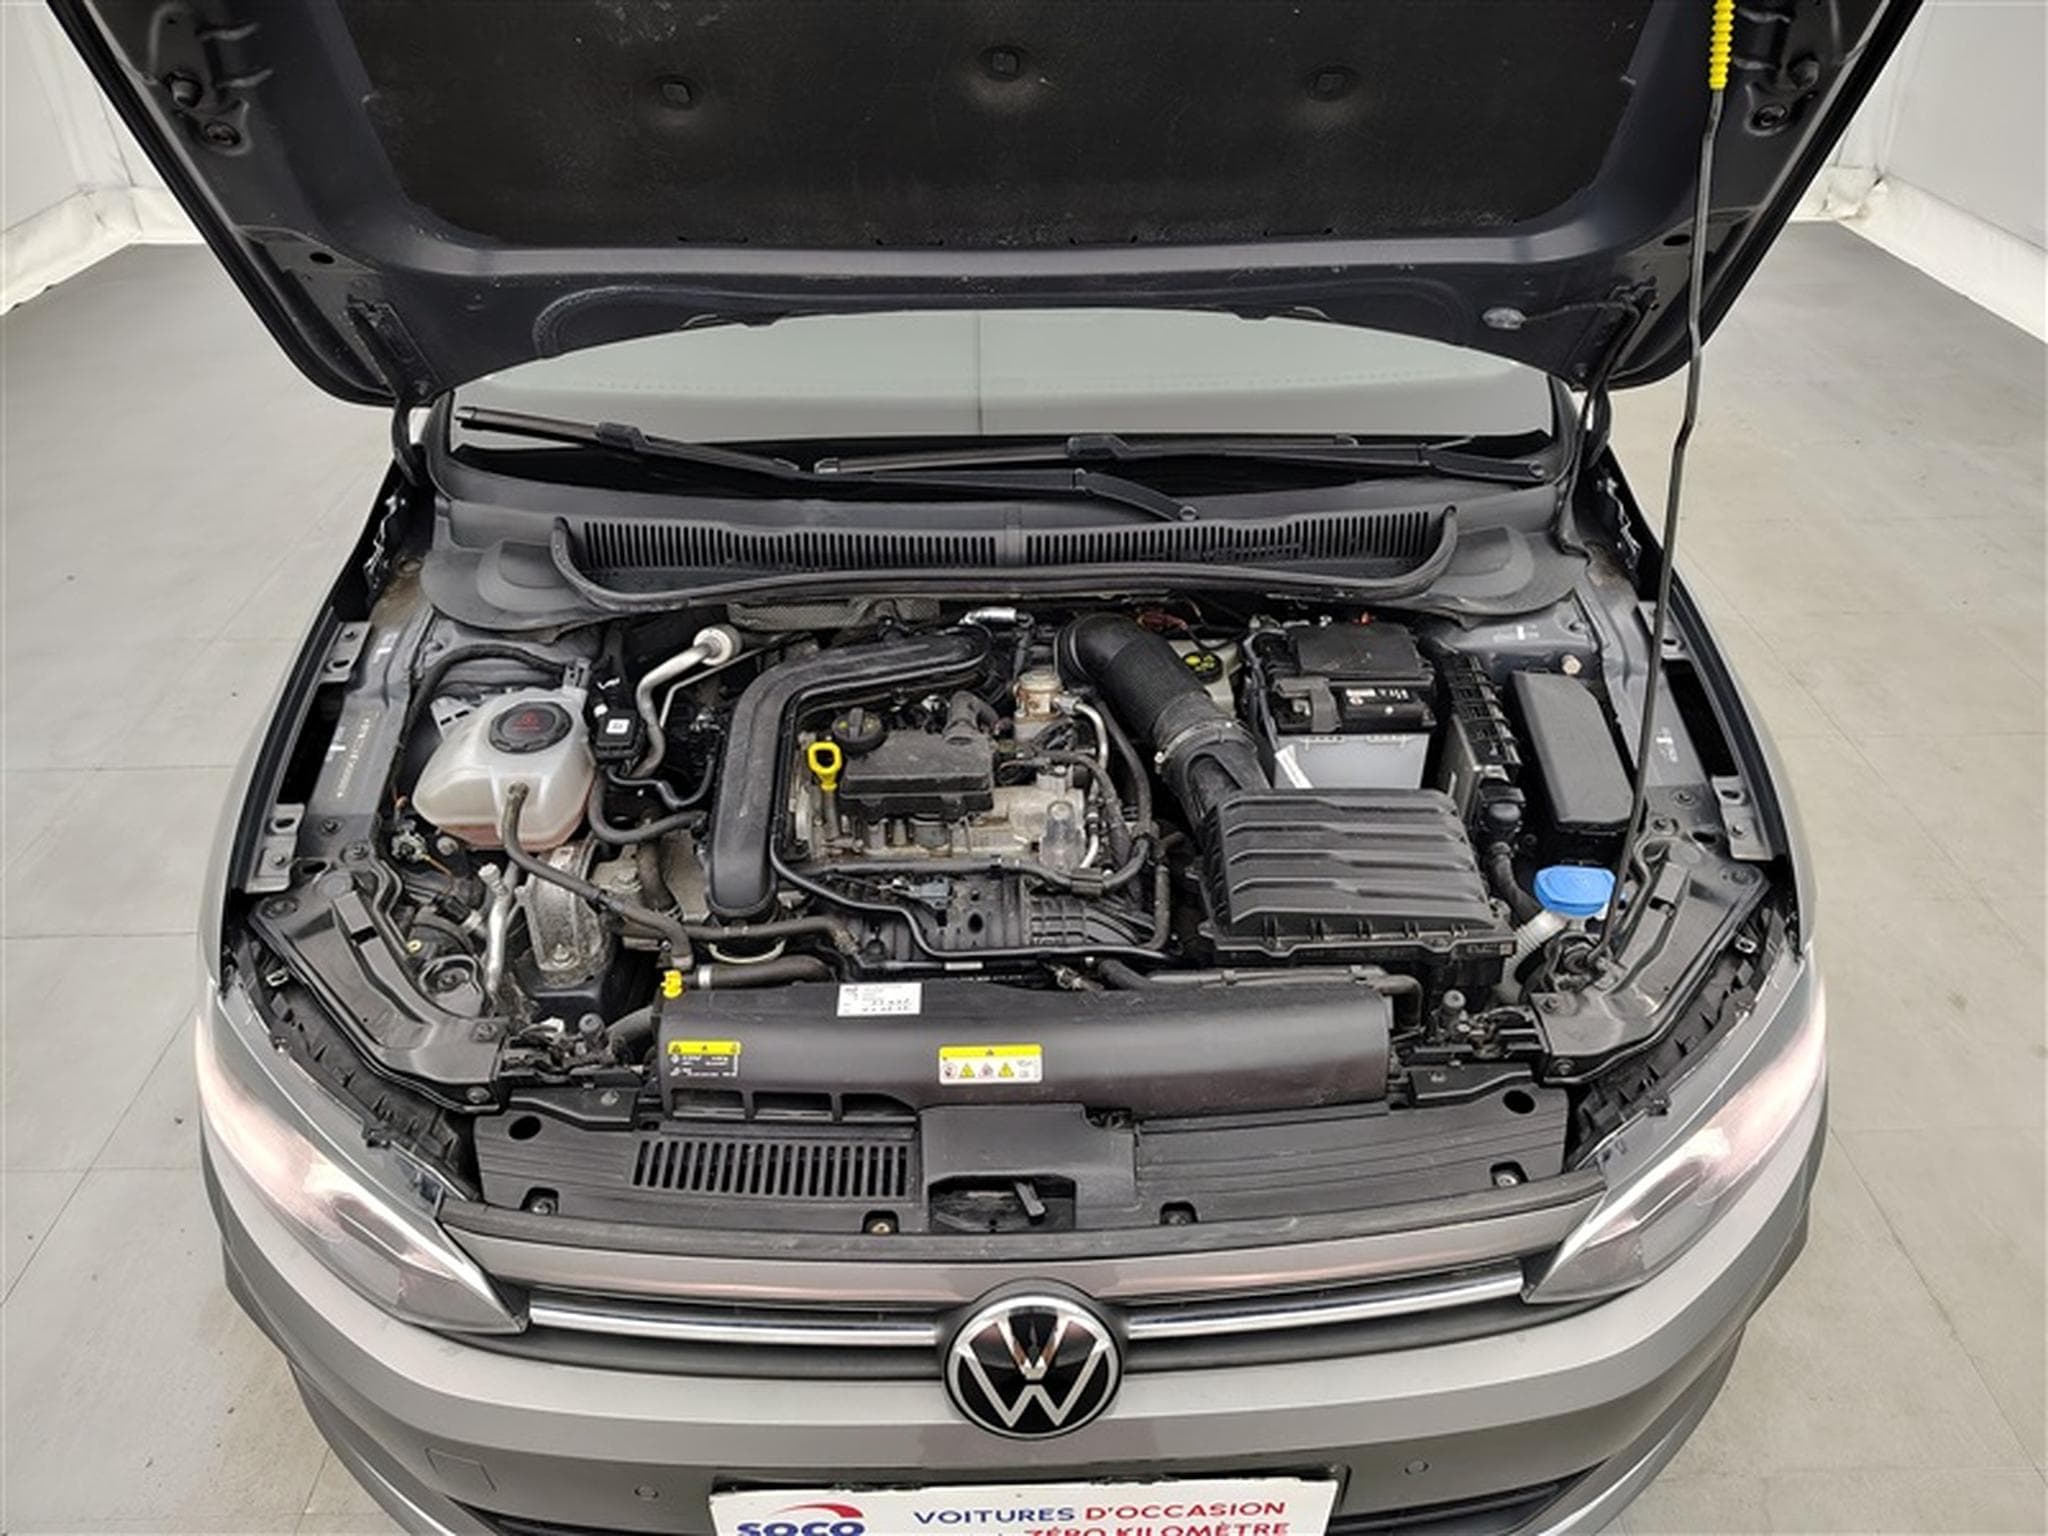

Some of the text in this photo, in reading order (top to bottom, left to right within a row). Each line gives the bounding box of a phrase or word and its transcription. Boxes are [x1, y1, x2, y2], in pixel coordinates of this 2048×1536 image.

[953, 1305, 1111, 1428] VW
[914, 1502, 1287, 1524] VOITURES D'OCCASION
